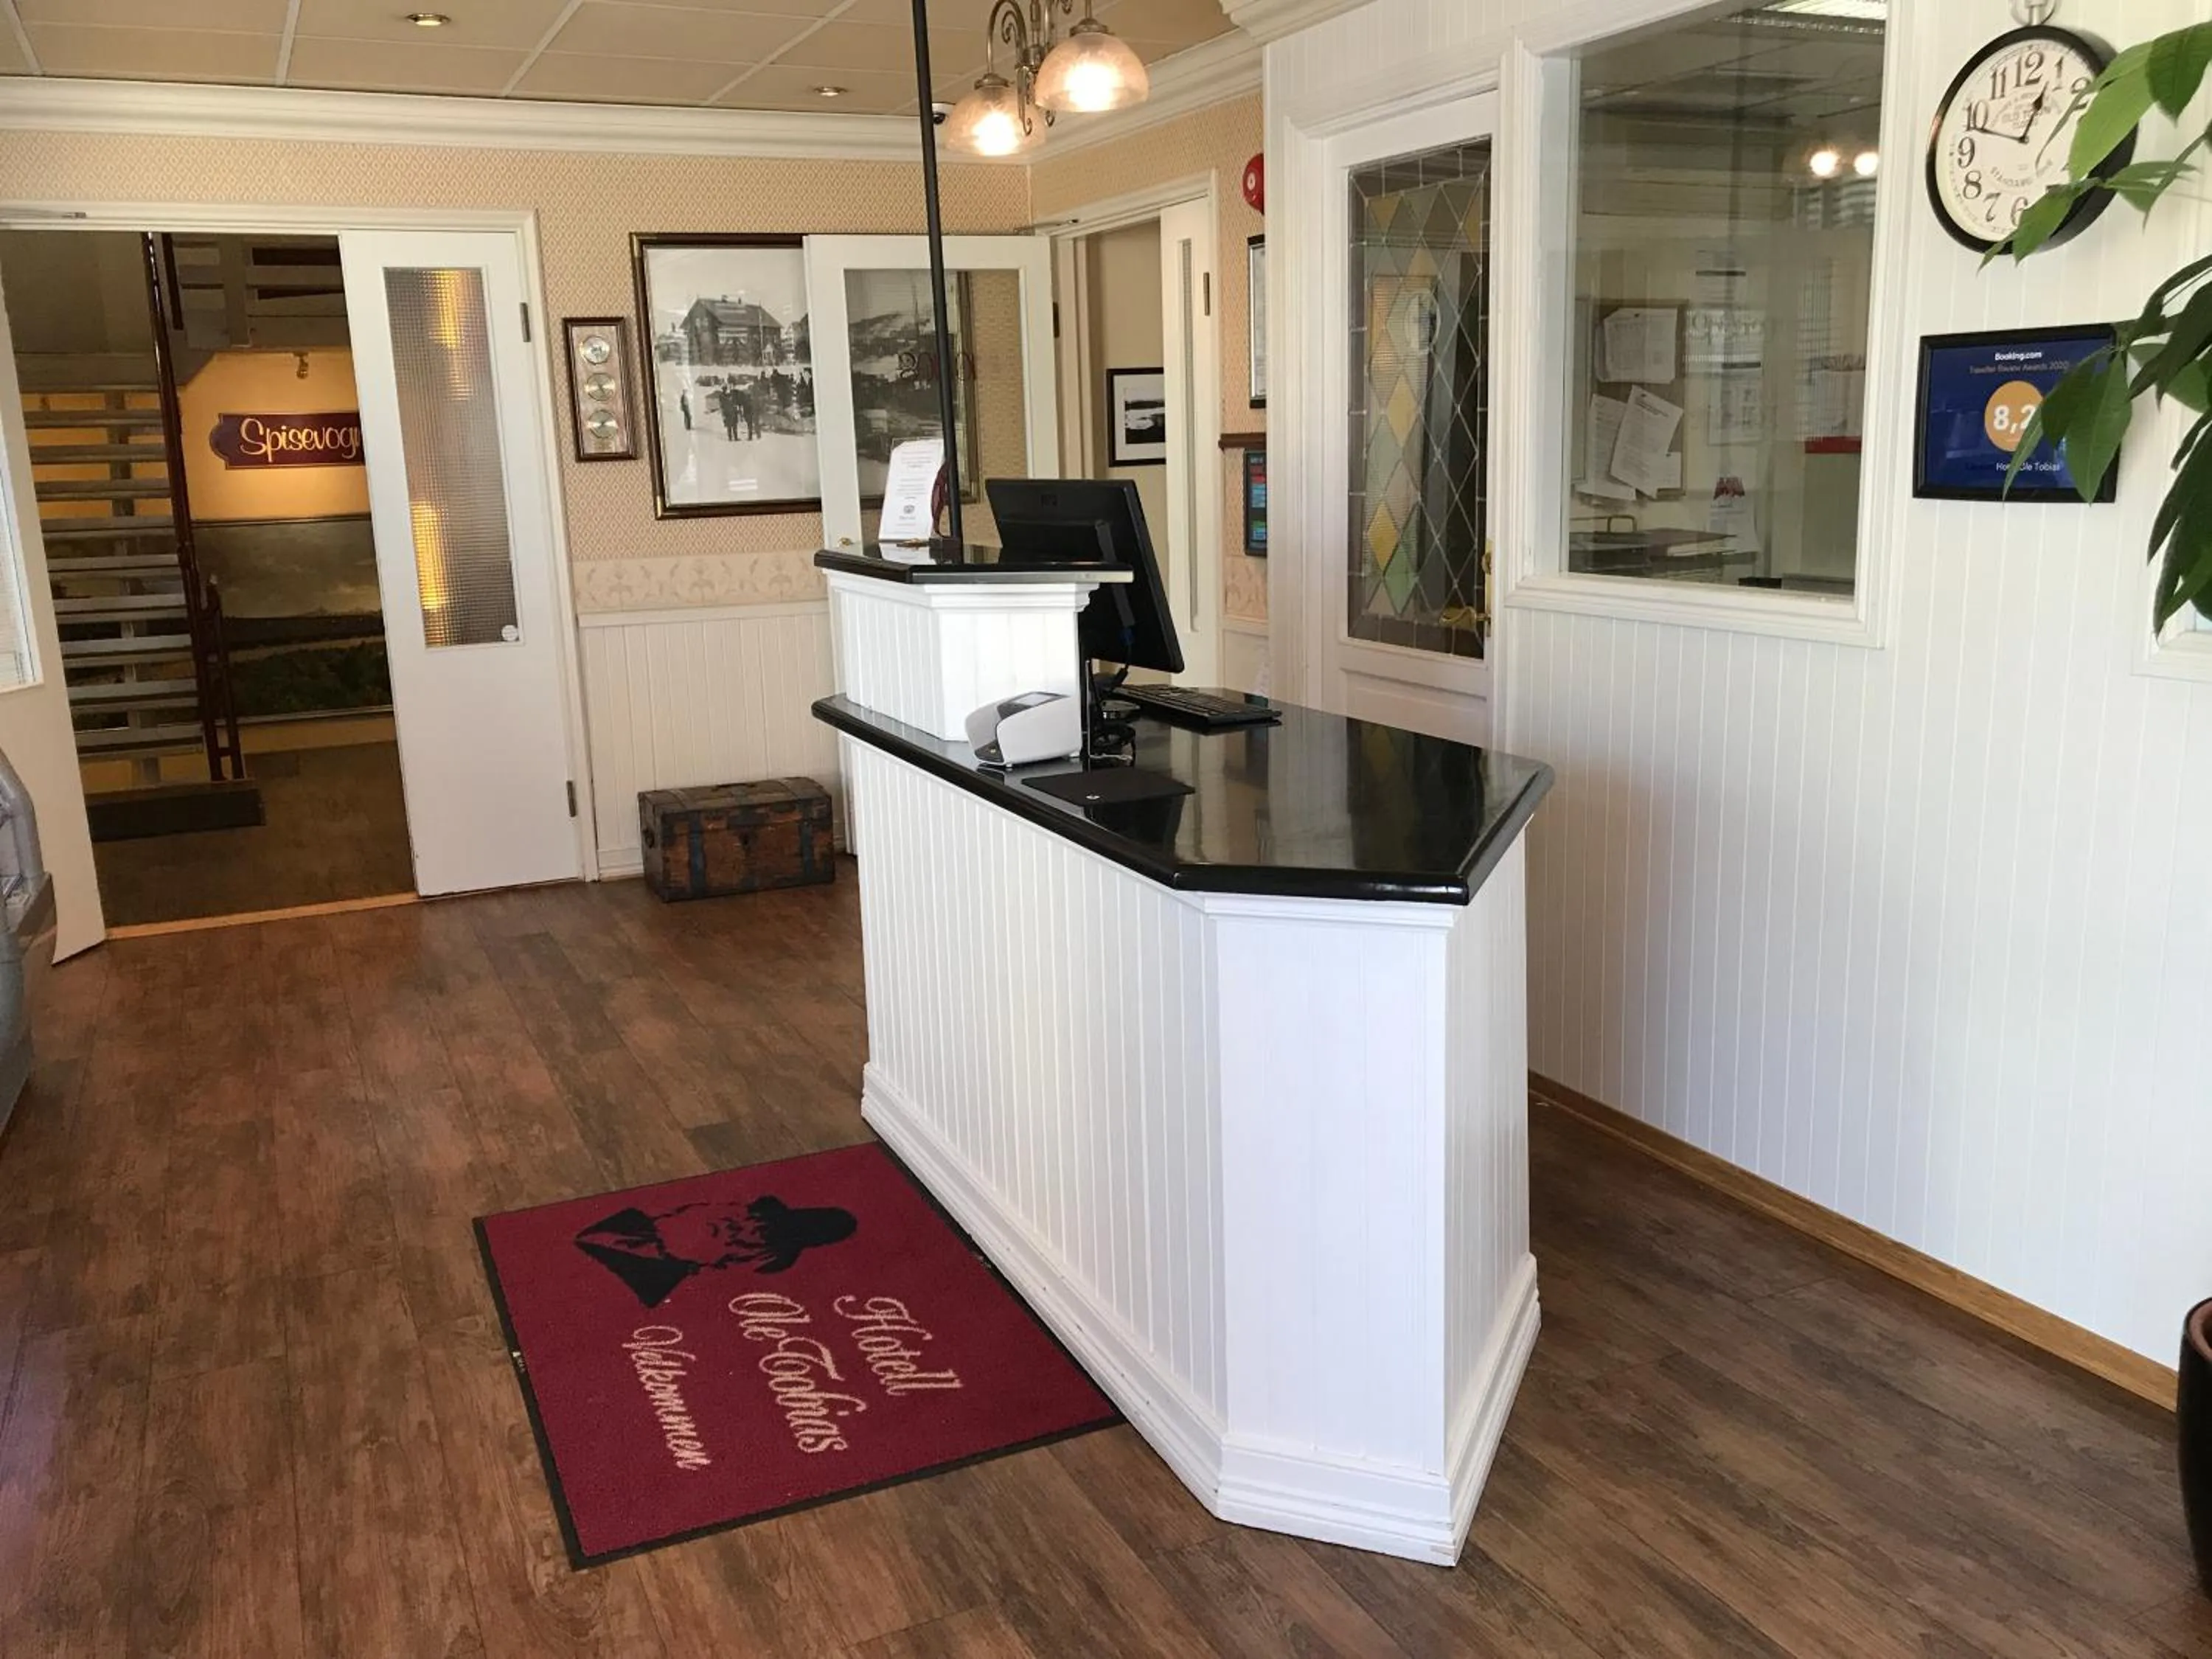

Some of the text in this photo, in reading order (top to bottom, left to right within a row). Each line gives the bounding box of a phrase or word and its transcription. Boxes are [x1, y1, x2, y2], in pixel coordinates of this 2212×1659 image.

[1990, 66, 2007, 101] 11
[2014, 52, 2045, 88] 12
[2052, 56, 2065, 92] 1
[2070, 77, 2092, 111] 2
[1965, 100, 1989, 132] 10
[1958, 136, 1975, 169] 9
[1963, 170, 1982, 199] 8
[1983, 192, 2002, 223] 7
[1994, 352, 2042, 361] Booking.com
[1992, 404, 2037, 434] 8,2
[2034, 462, 2062, 471] Tobias
[834, 1295, 963, 1396] Hotell
[728, 1292, 866, 1453] Ole Tobias
[622, 1325, 712, 1471] Velkommen
